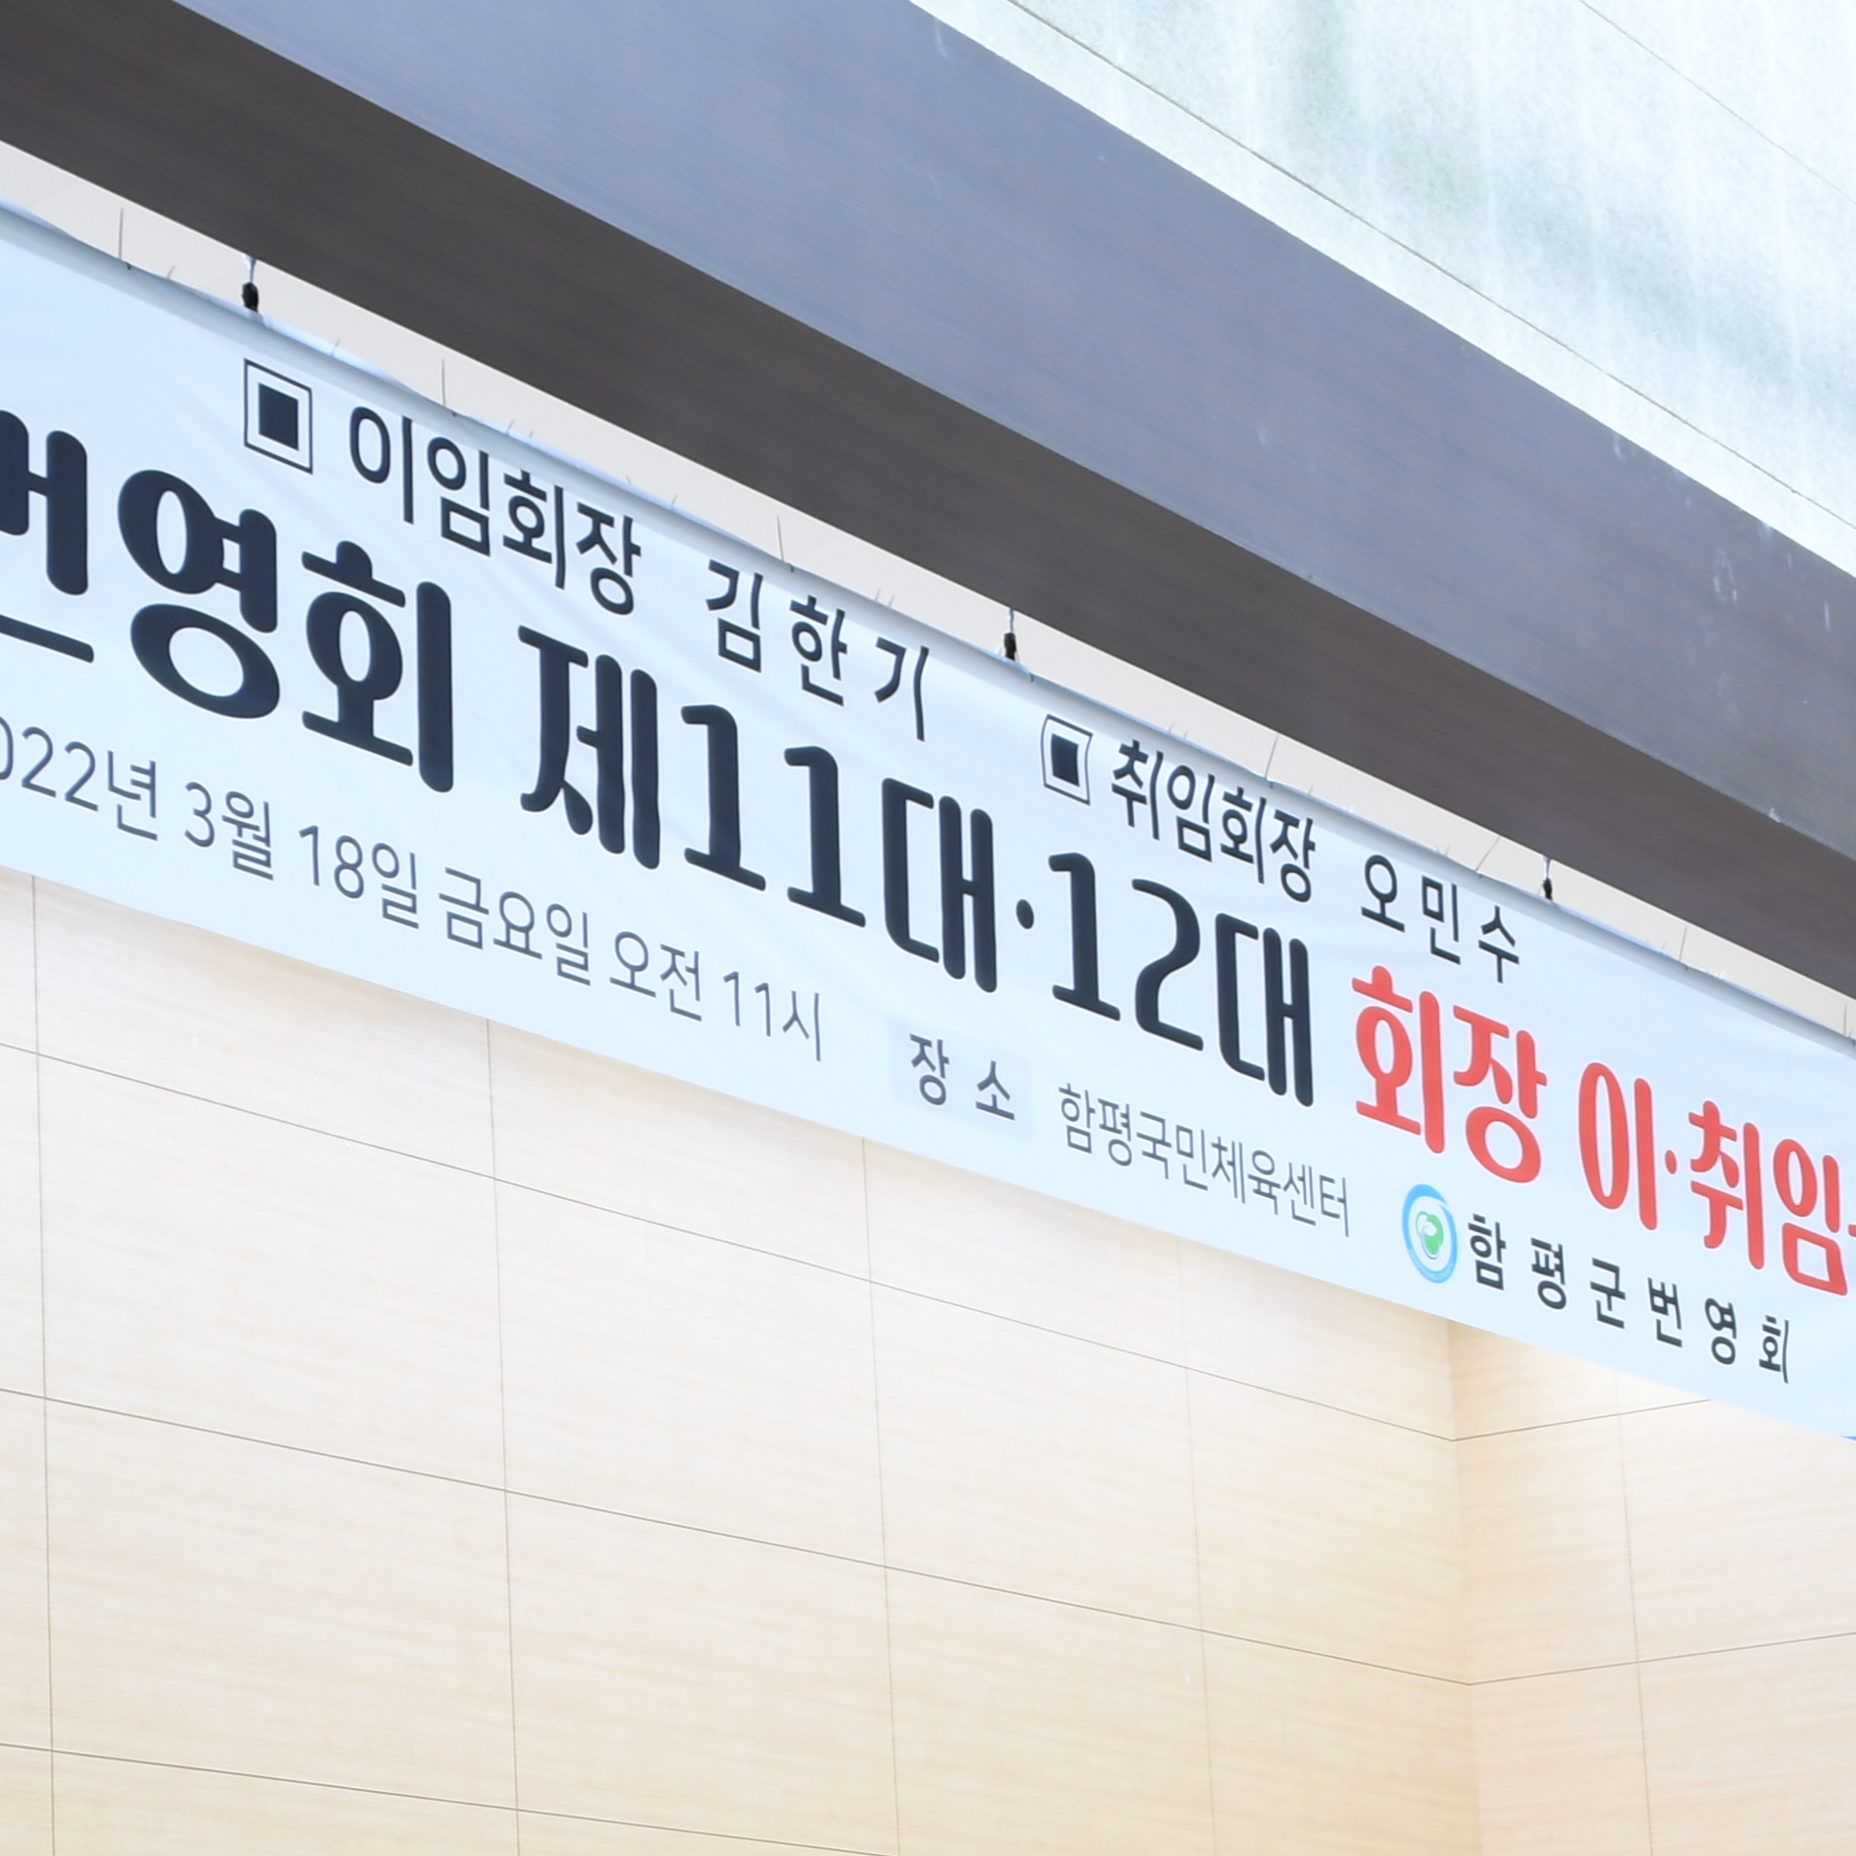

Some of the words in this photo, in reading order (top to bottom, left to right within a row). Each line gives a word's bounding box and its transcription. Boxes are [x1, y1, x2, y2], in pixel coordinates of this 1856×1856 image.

[349, 404, 642, 617] 이임회장
[183, 780, 275, 882] 3월
[298, 825, 421, 931] 18일
[438, 865, 592, 987] 금요일
[608, 929, 704, 1024] 오전
[721, 969, 823, 1064] 11시
[1111, 738, 1317, 903] 취임회장
[1058, 1083, 1351, 1240] 함평국민체육센터
[1351, 965, 1545, 1184] 회장
